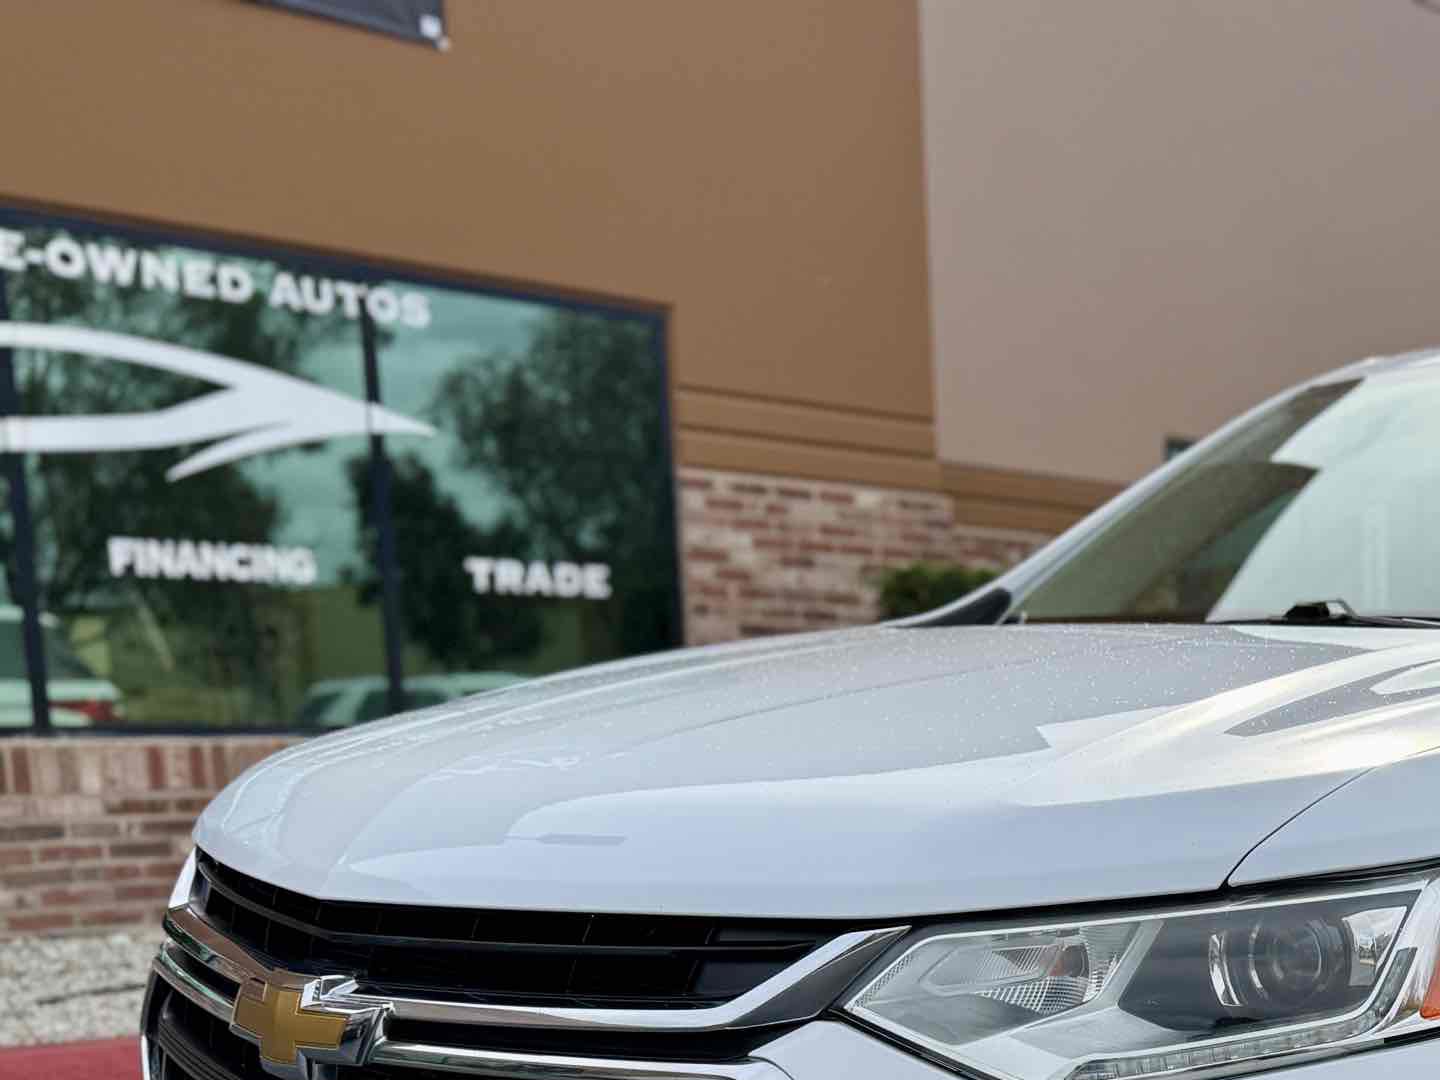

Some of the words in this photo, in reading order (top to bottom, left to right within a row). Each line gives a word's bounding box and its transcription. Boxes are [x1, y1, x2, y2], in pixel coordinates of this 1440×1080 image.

[266, 271, 431, 329] AUTOS
[106, 536, 318, 586] FINANCING
[462, 556, 612, 601] TRADE
